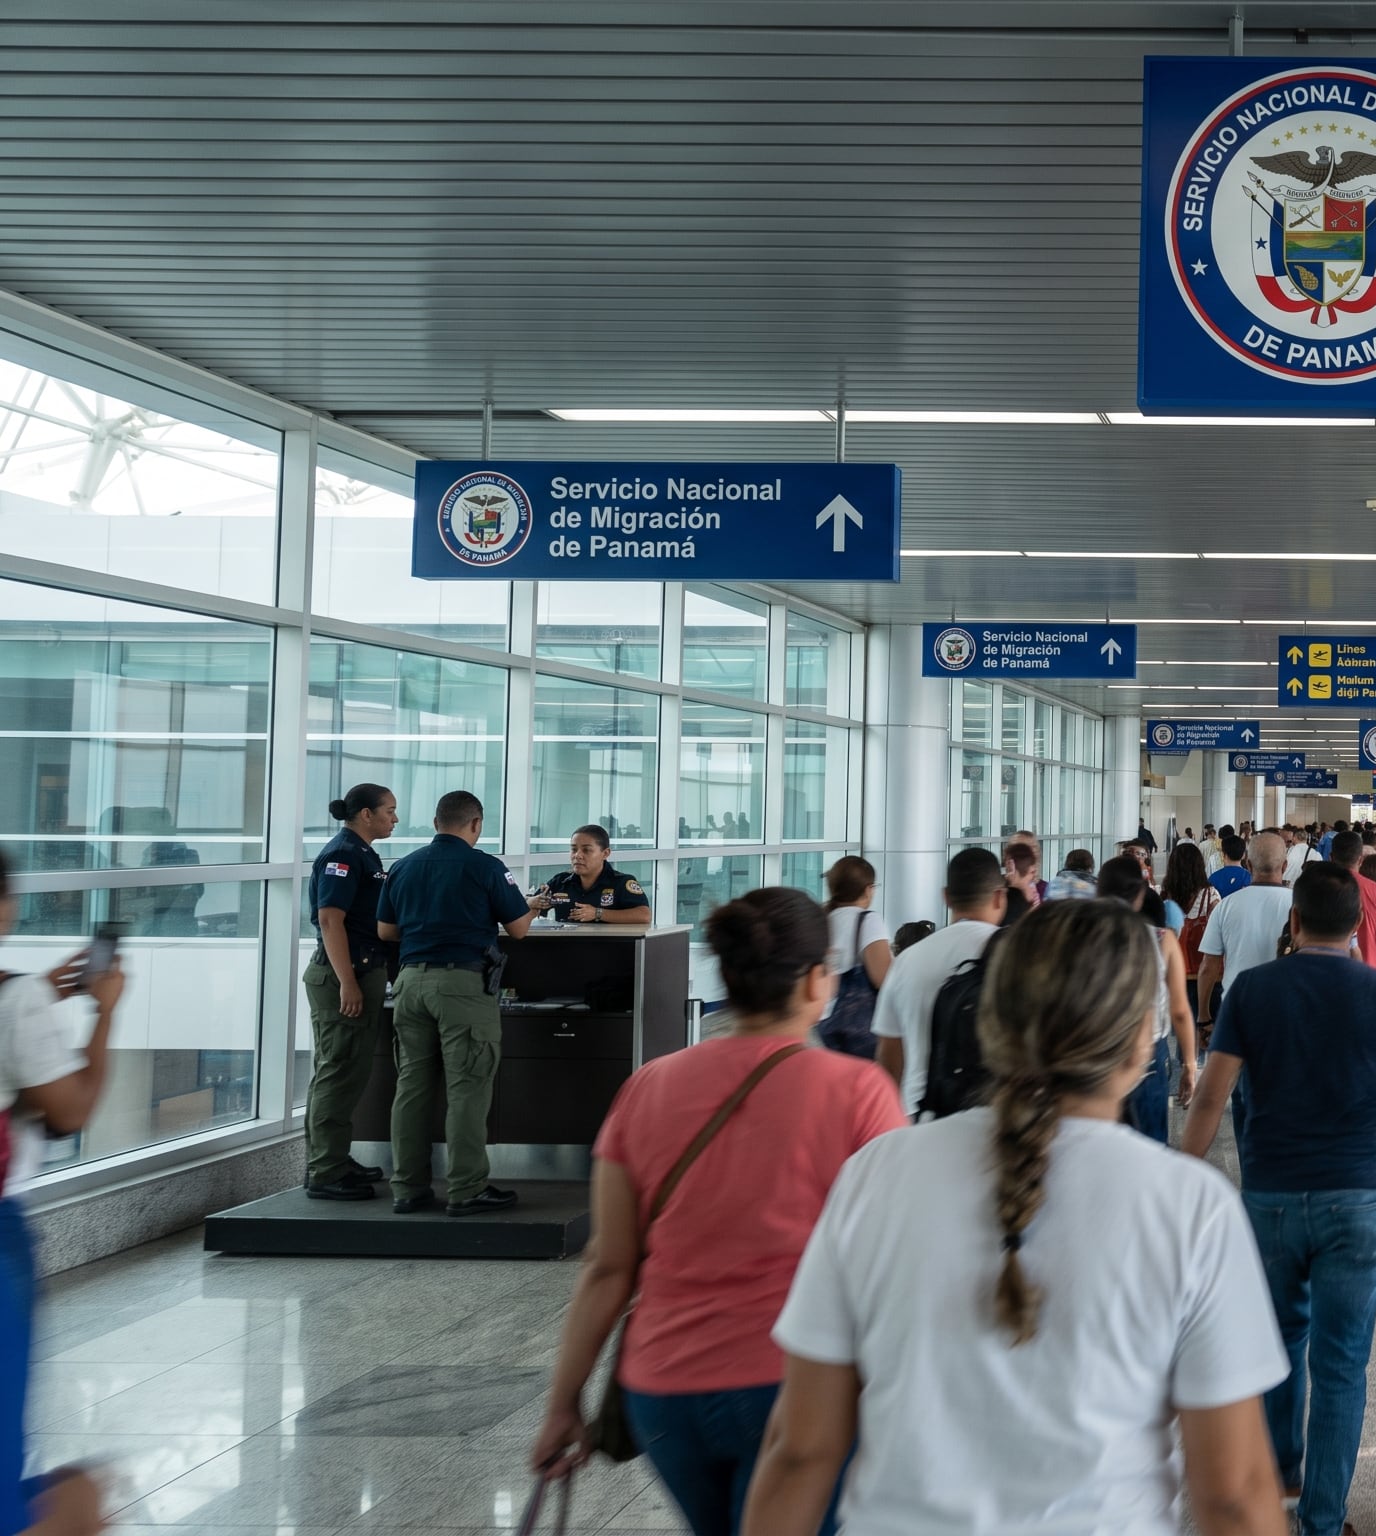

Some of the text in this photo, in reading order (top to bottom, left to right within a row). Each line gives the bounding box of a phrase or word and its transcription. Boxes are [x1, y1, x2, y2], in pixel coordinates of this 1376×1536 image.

[1184, 126, 1238, 232] SERVICIO
[1236, 84, 1356, 130] NACIONAL
[1243, 324, 1281, 359] DE
[551, 477, 780, 500] Servicio Nacional
[550, 506, 720, 534] de Migración
[550, 536, 695, 558] de Panamá
[983, 631, 1032, 641] Servicio
[1036, 632, 1087, 642] Nacional
[984, 644, 1060, 657] de Migración
[983, 658, 1049, 668] de Panamá
